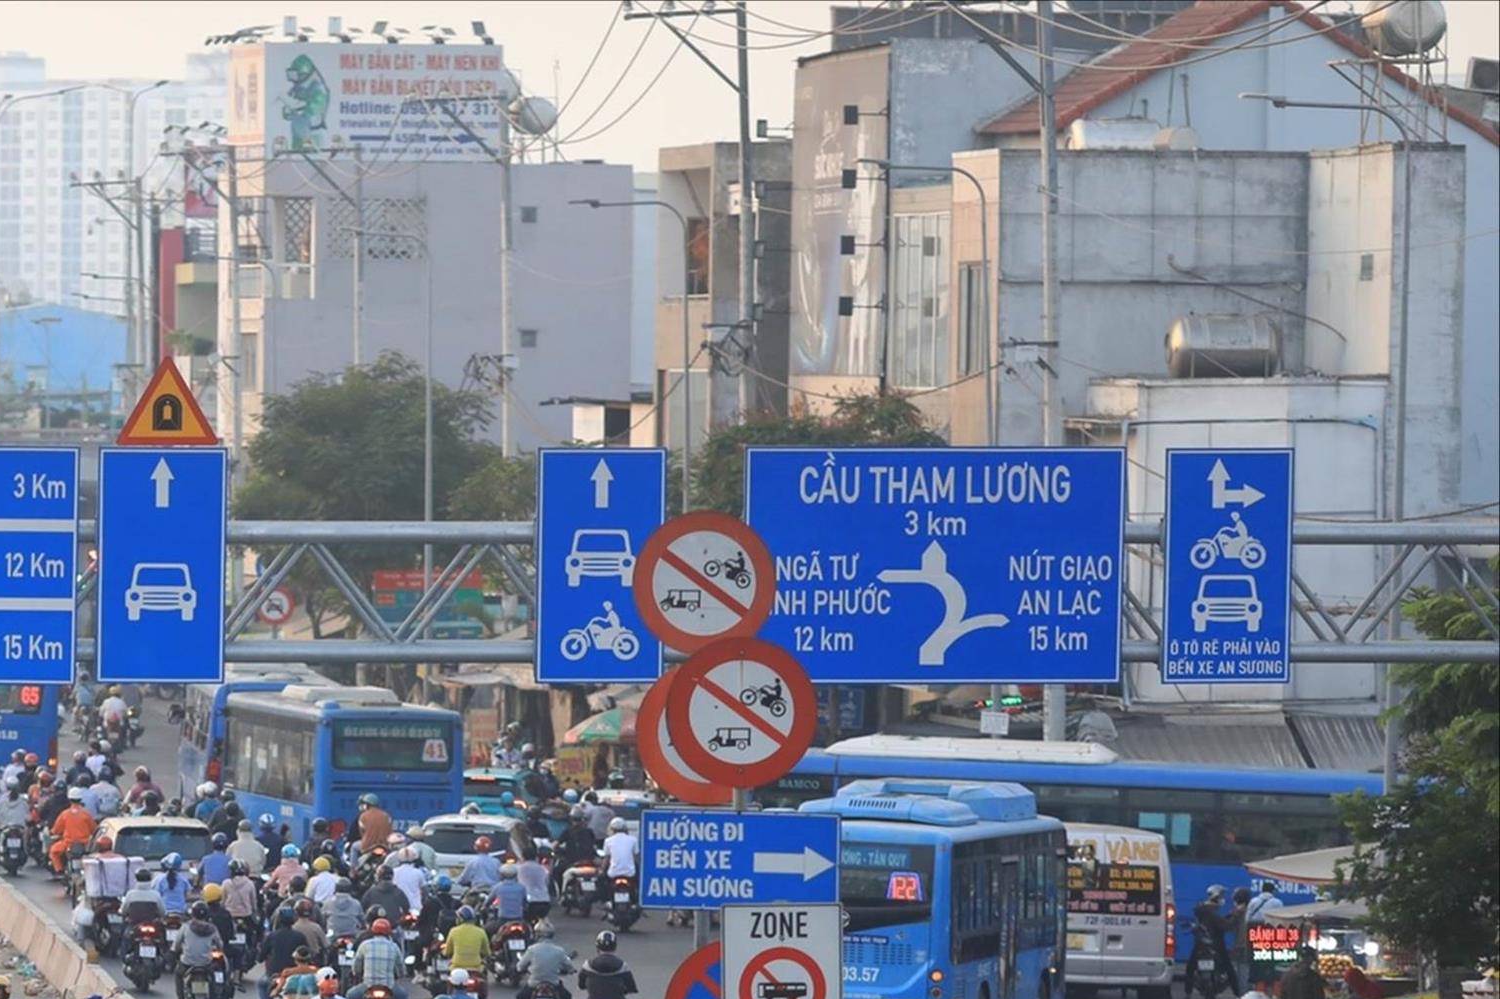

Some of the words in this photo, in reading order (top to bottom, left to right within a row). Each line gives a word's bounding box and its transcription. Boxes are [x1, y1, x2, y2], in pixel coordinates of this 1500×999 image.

[339, 101, 396, 115] Hotline:
[12, 473, 26, 499] 3
[31, 473, 67, 499] Km
[799, 451, 862, 504] CẦU
[868, 464, 956, 505] THAM
[965, 461, 1073, 505] LƯƠNG
[904, 510, 920, 536] 3
[927, 510, 967, 536] km
[4, 552, 24, 578] 12
[29, 552, 65, 579] Km
[775, 550, 824, 582] NGÃ
[828, 552, 861, 581] TƯ
[1009, 548, 1056, 582] NÚT
[768, 589, 807, 616] NH
[814, 582, 892, 616] PHƯỚC
[1017, 589, 1051, 616] AN
[1057, 589, 1102, 621] LẠC
[3, 634, 23, 659] 15
[28, 634, 64, 660] Km
[793, 625, 814, 652] 12
[820, 625, 854, 652] km
[1028, 625, 1049, 651] 15
[1055, 625, 1088, 651] km
[1222, 636, 1253, 655] PHẢI
[1255, 636, 1281, 655] VÀO
[1168, 656, 1194, 675] BẾN
[1197, 660, 1214, 675] XE
[1216, 660, 1236, 675] AN
[21, 685, 40, 706] 65
[425, 742, 446, 759] 41
[648, 814, 719, 842] HƯỚNG
[722, 822, 745, 843] ĐI
[655, 842, 697, 870] BẾN
[704, 850, 732, 870] XE
[1107, 836, 1160, 862] VÀNG
[647, 877, 677, 898] AN
[683, 876, 754, 899] SƯƠNG
[750, 911, 808, 939] ZONE
